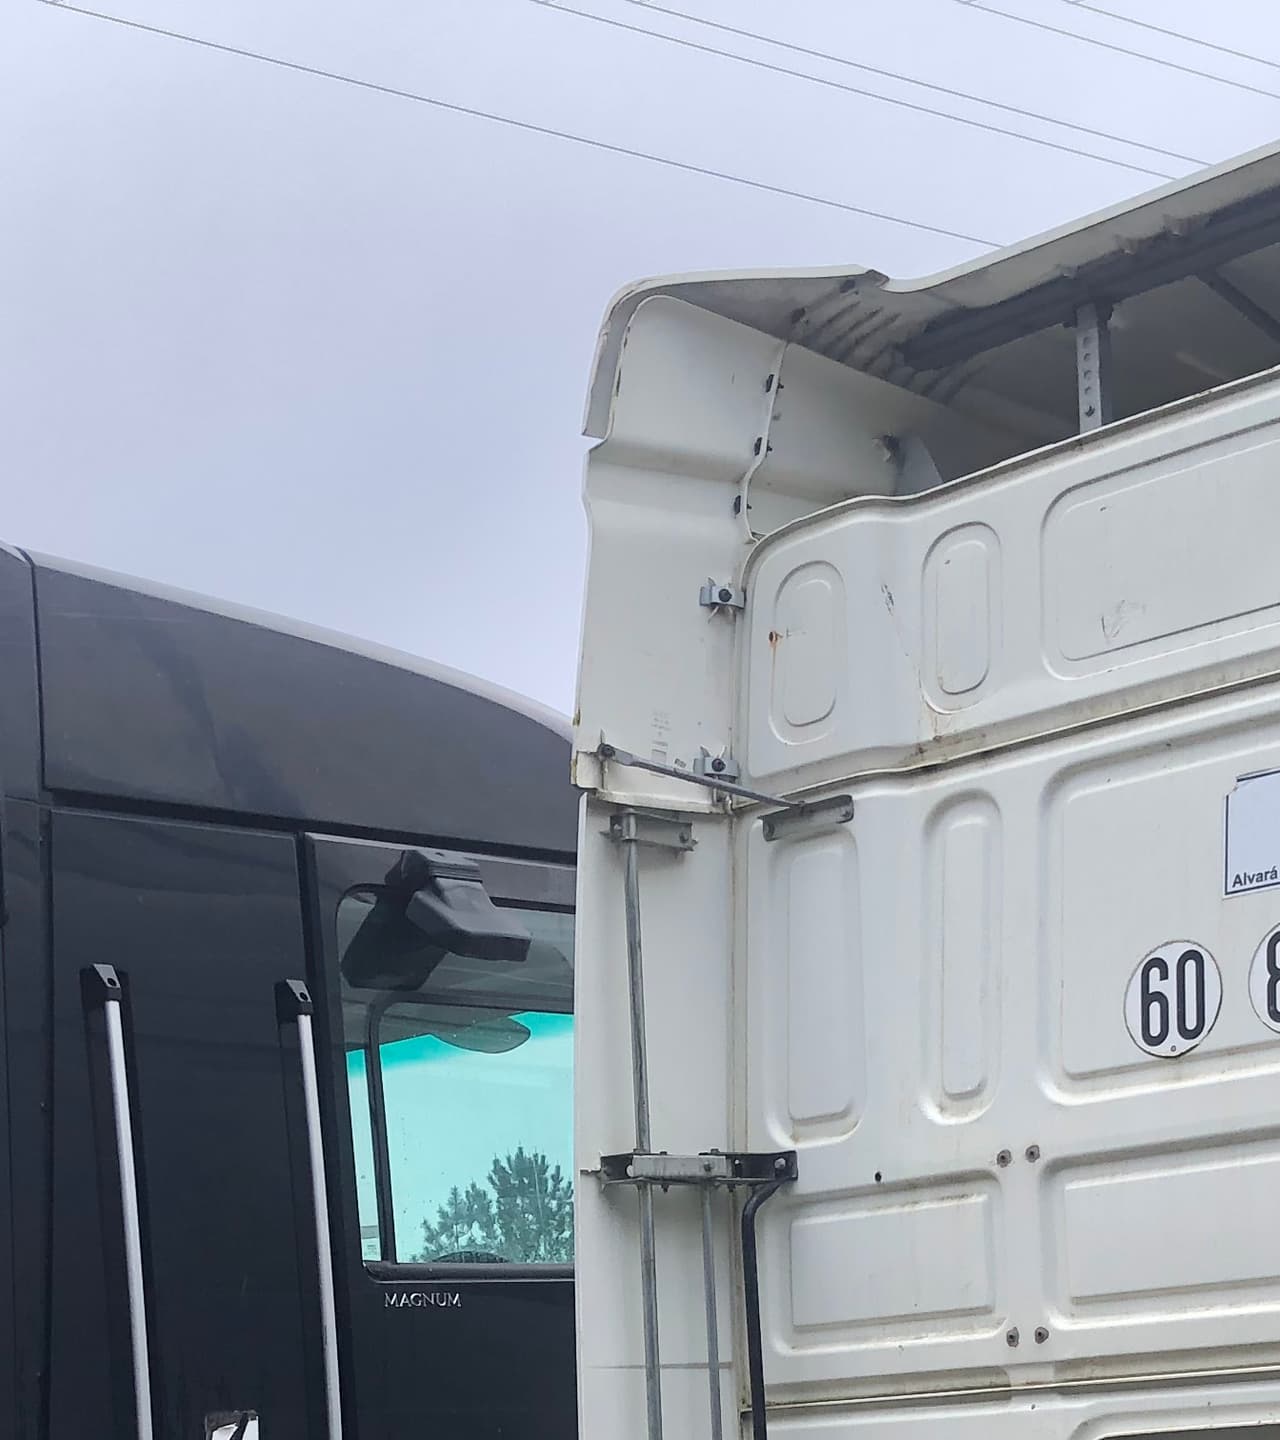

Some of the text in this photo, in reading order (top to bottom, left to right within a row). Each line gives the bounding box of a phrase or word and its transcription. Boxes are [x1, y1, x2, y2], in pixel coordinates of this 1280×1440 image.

[1232, 866, 1279, 888] Alvará
[1140, 948, 1206, 1047] 60
[384, 1292, 462, 1308] MAGNUM
